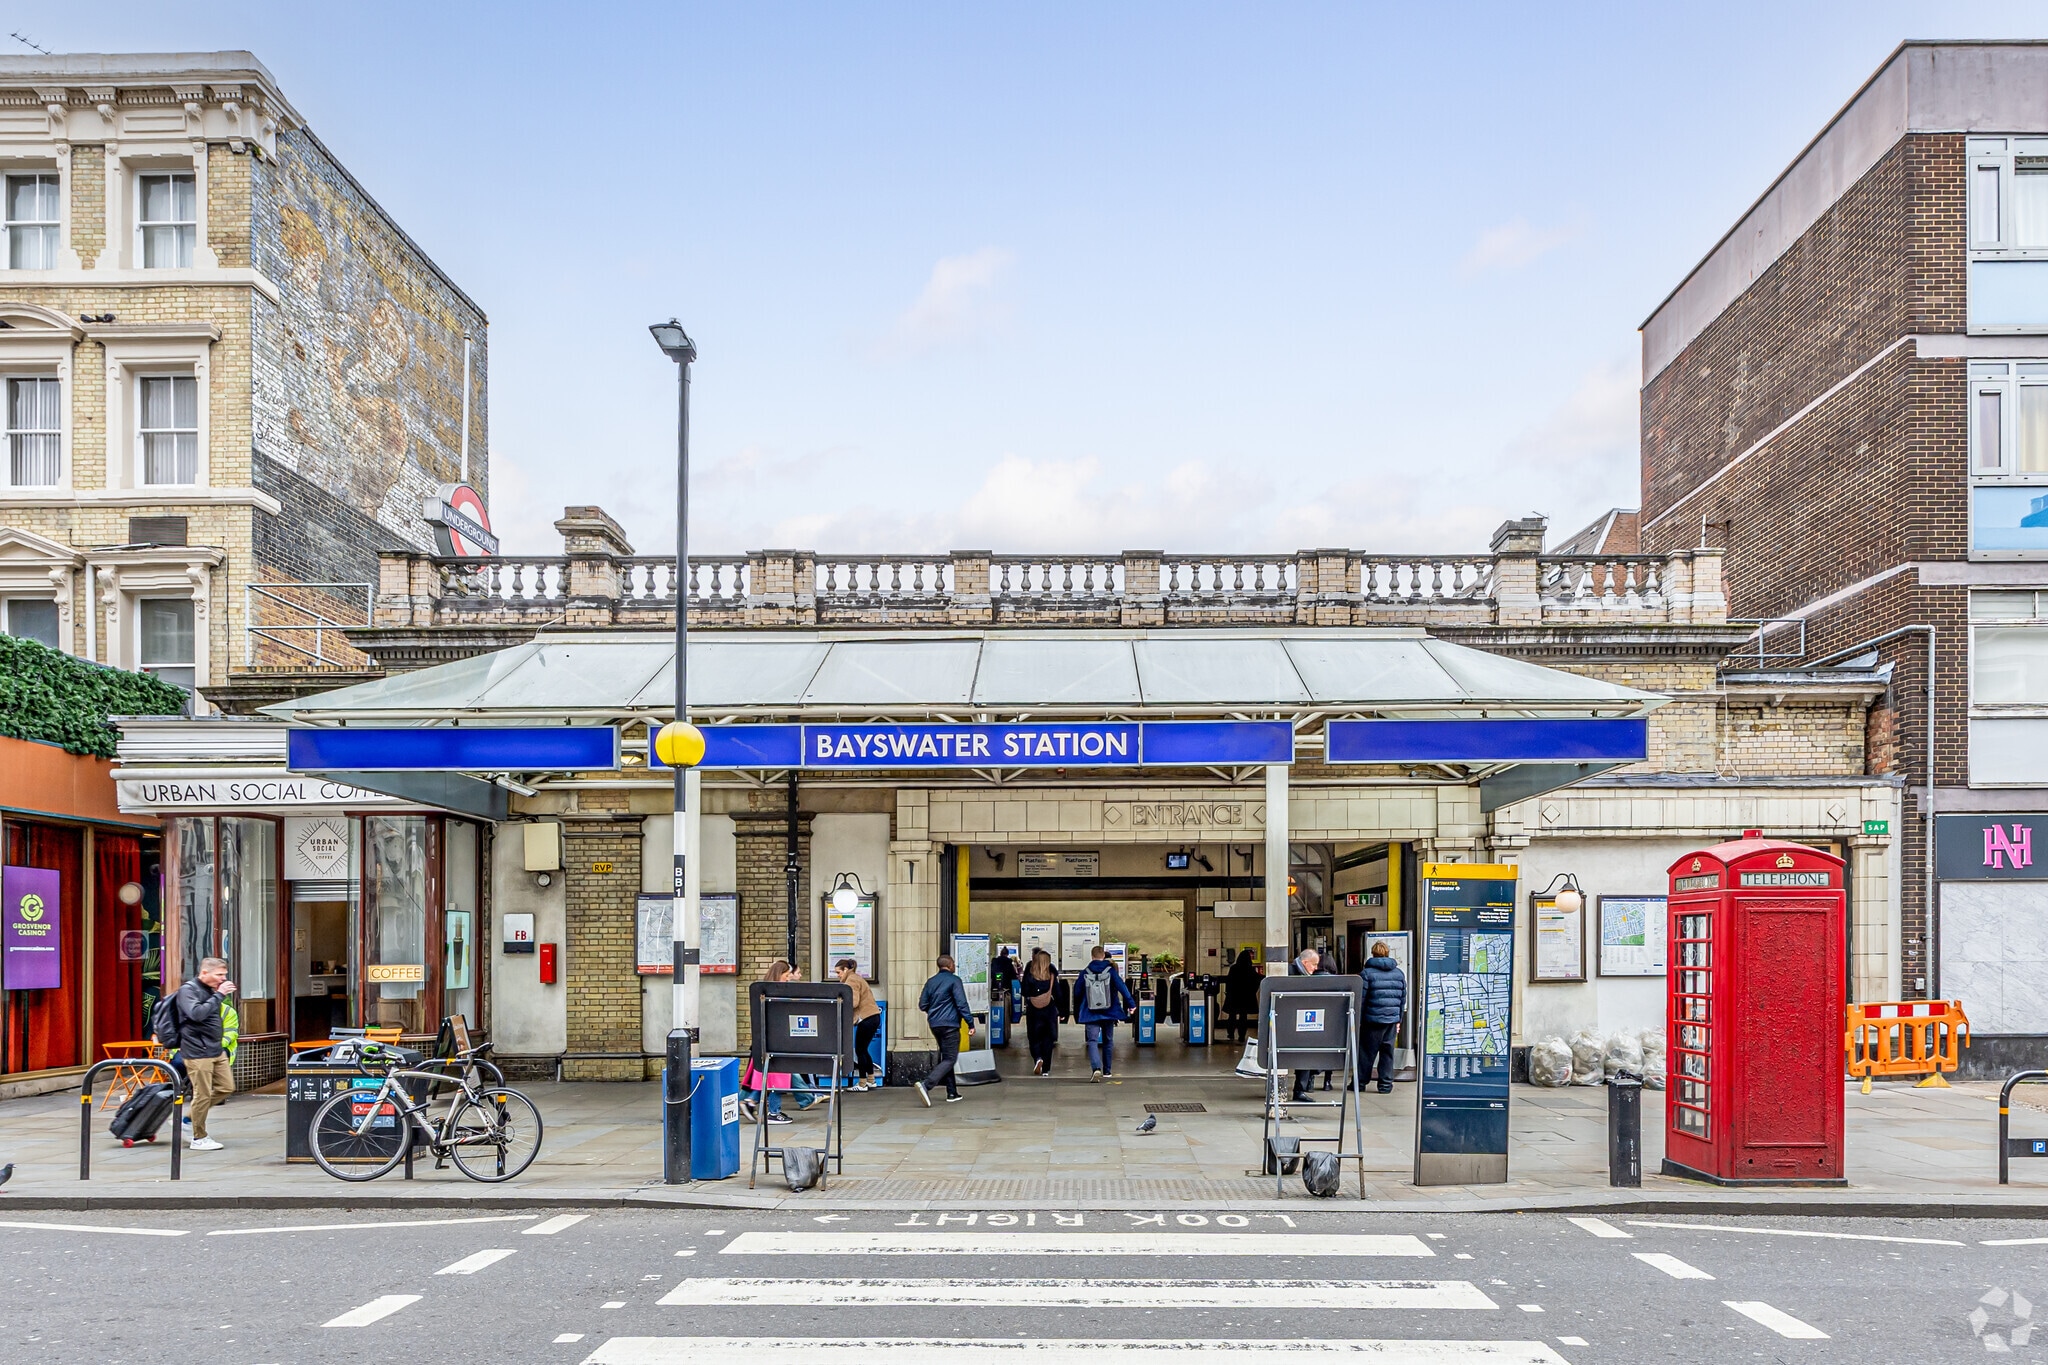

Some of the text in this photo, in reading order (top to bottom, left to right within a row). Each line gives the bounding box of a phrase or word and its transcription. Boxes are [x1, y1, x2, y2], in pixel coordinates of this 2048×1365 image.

[443, 507, 497, 552] UNDERGROUND
[816, 732, 1127, 758] BAYSWATER STATION
[142, 784, 216, 802] URBAN
[230, 783, 306, 801] SOCIAL
[1132, 804, 1243, 826] ENTRANCE
[594, 864, 612, 872] RVP
[1744, 873, 1825, 885] TELEPHONE
[514, 930, 527, 941] FB
[371, 967, 421, 979] COFFEE
[893, 1212, 1297, 1228] LOOK RIGHT
